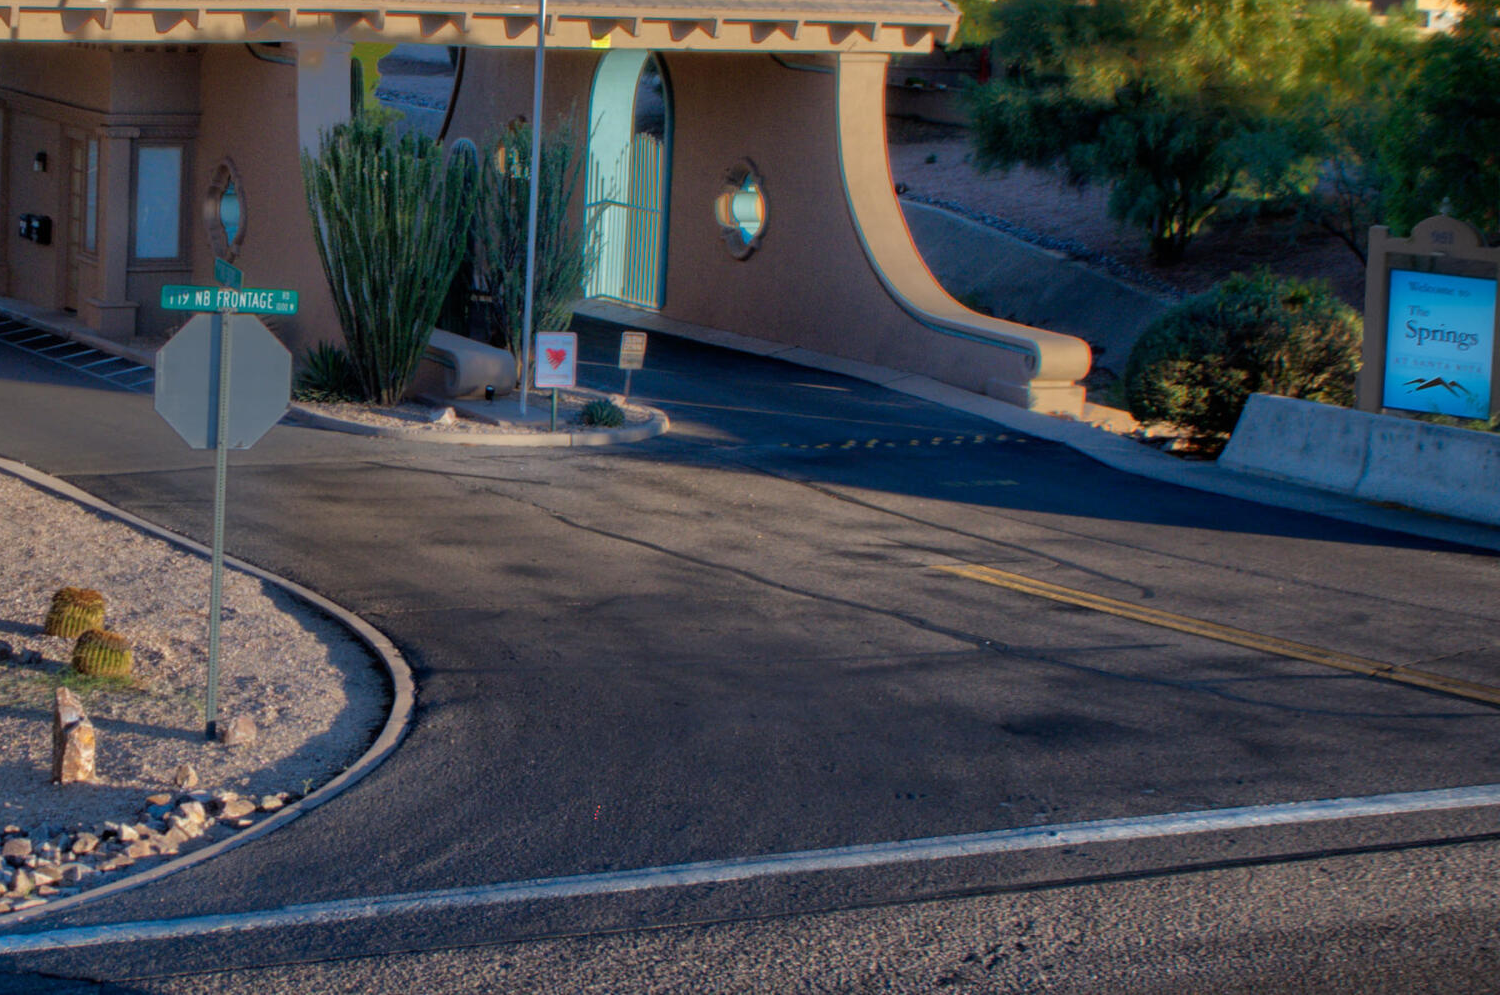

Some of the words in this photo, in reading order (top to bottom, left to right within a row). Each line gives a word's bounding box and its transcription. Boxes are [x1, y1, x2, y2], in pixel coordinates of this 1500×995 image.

[1408, 281, 1454, 296] Welcome
[195, 290, 211, 307] NB
[216, 291, 274, 310] FRONTAGE
[1408, 305, 1430, 318] The
[1405, 320, 1479, 351] Springs
[1411, 358, 1450, 370] SANTA
